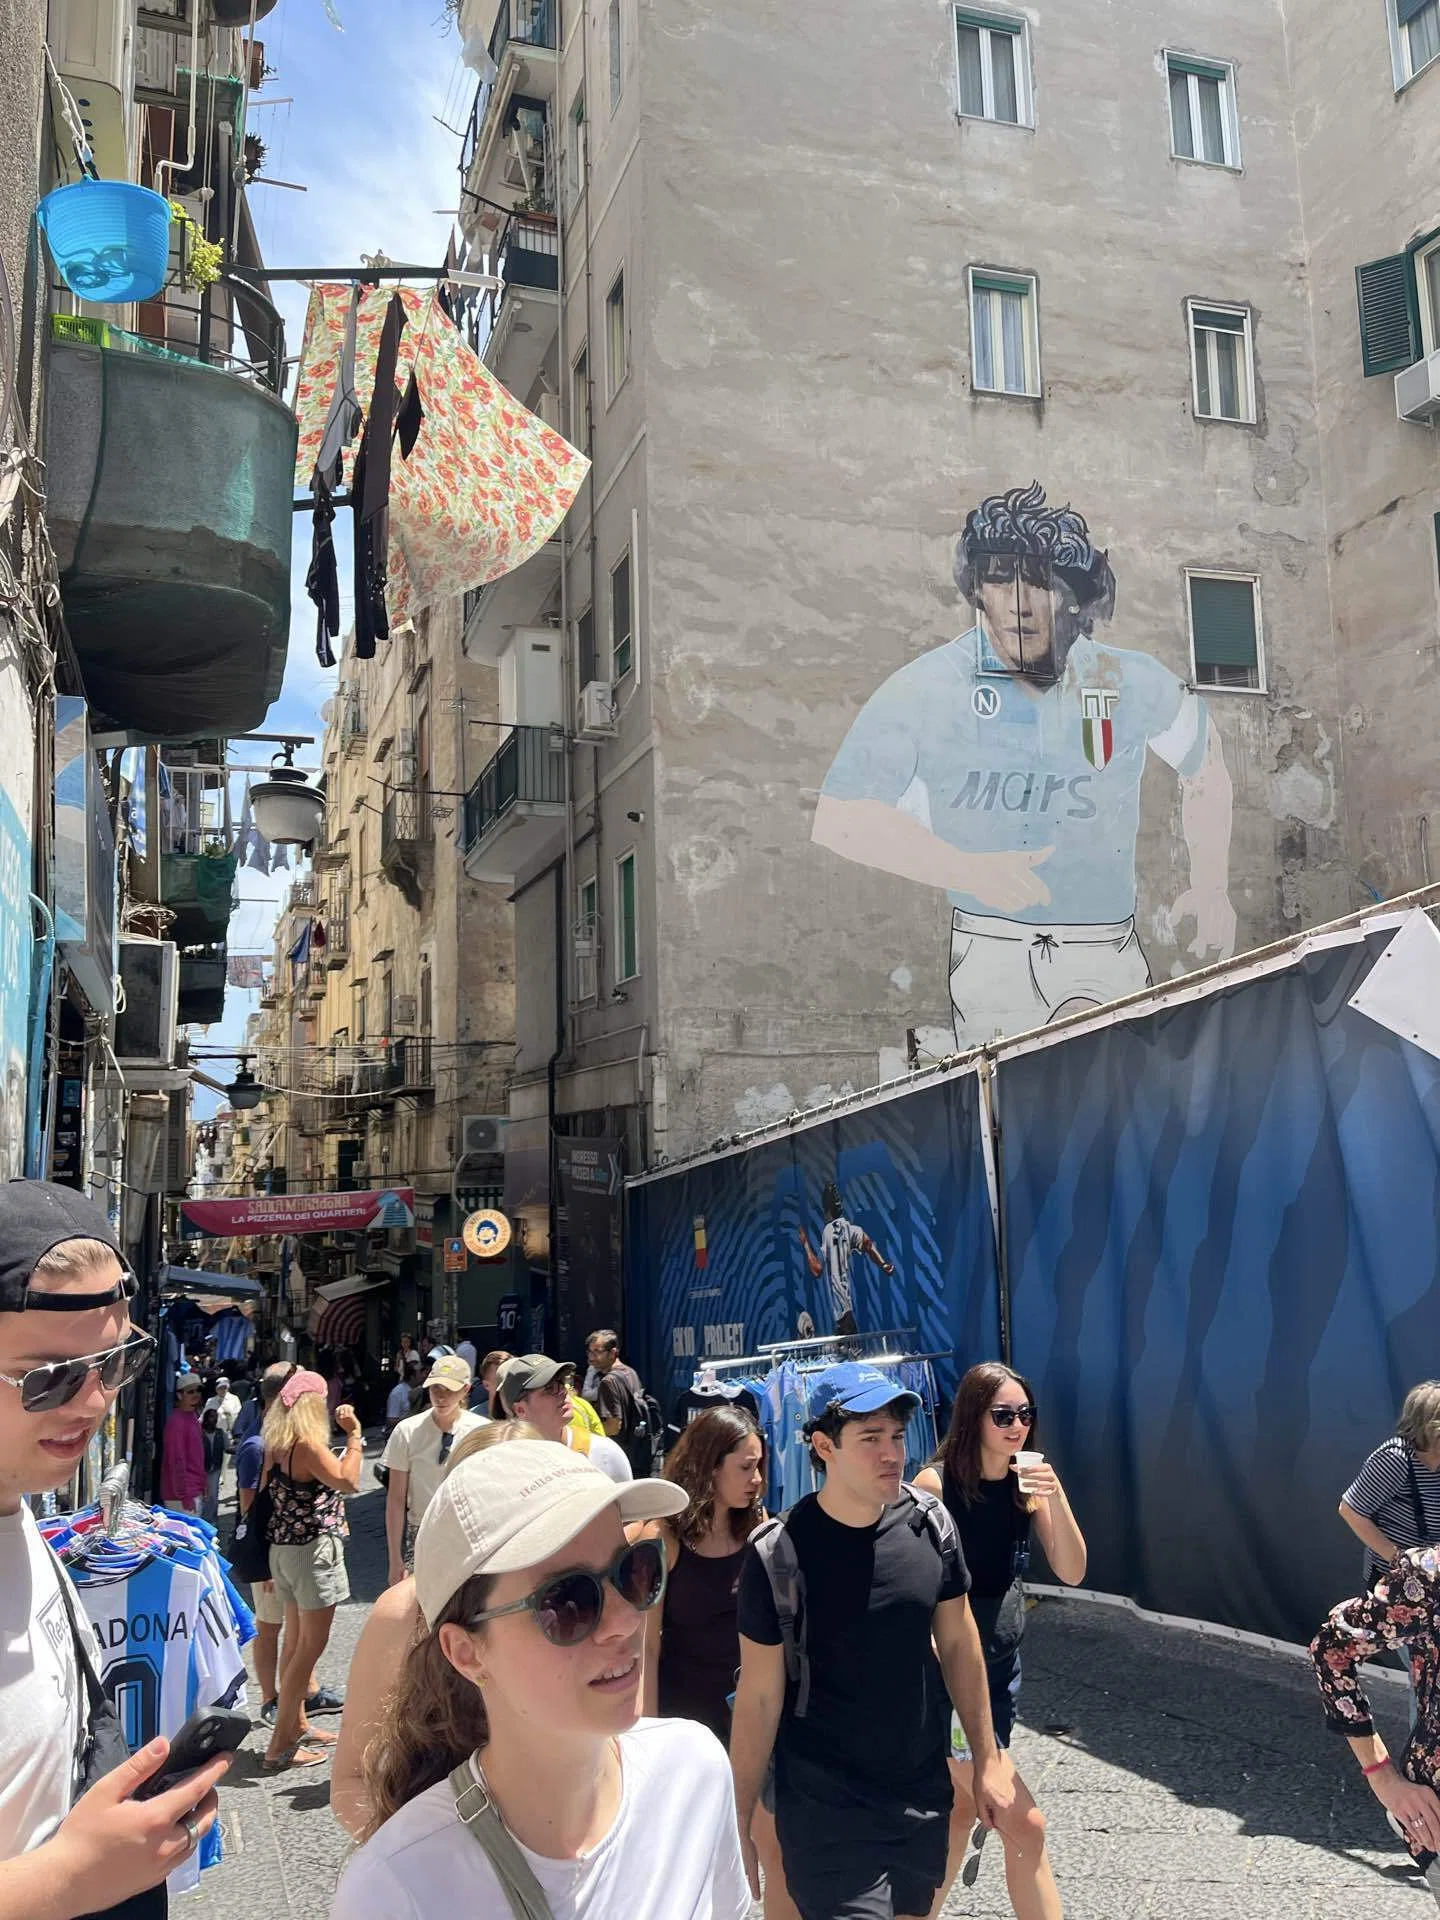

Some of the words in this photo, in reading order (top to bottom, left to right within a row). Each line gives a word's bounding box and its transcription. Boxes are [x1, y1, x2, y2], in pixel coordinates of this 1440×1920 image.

[231, 1215, 246, 1224] LA
[247, 1212, 293, 1222] PIZZERIA
[294, 1211, 311, 1220] DEI
[313, 1208, 366, 1219] QUARTIERI
[500, 1310, 516, 1329] 10
[703, 1322, 745, 1356] PROJECT
